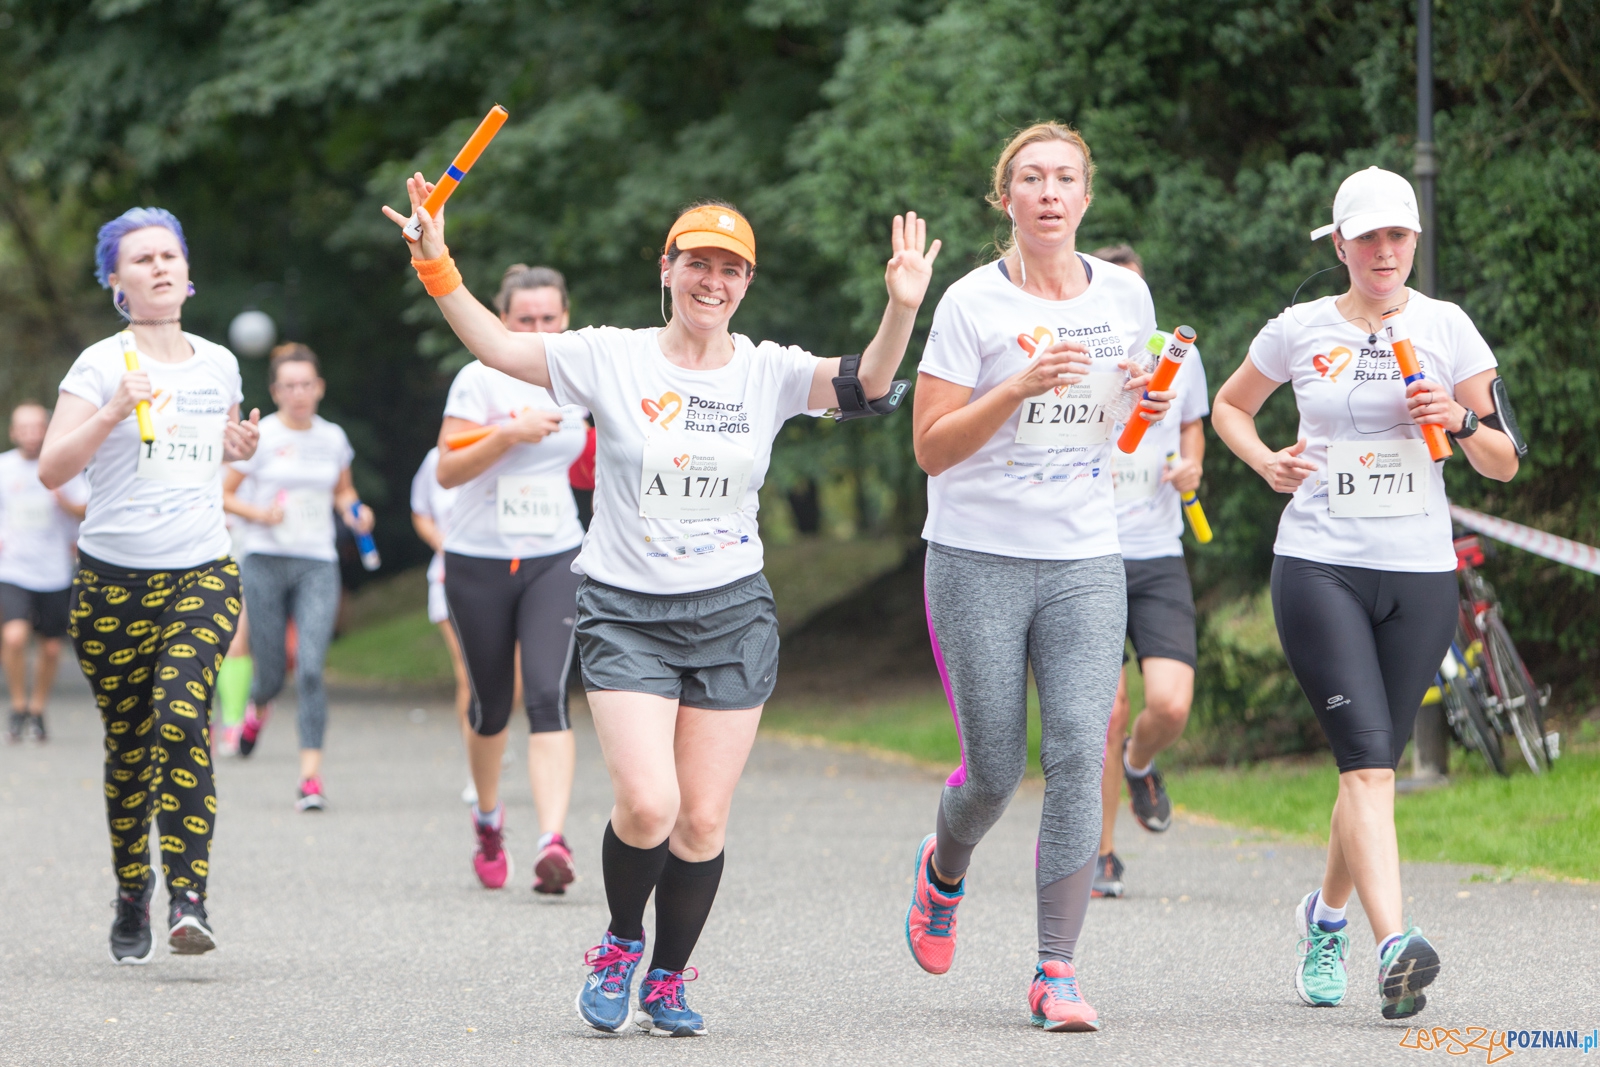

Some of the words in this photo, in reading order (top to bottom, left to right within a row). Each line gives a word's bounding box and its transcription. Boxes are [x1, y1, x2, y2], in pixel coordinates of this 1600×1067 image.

[1057, 322, 1111, 337] Poznań
[1094, 345, 1124, 358] 2016
[1168, 343, 1188, 358] 202
[1353, 370, 1388, 381] Run
[1025, 402, 1046, 424] E
[684, 420, 716, 432] Run
[718, 422, 750, 434] 2016
[166, 442, 213, 462] 274/1
[645, 472, 669, 496] A
[681, 475, 729, 498] 17/1
[1335, 472, 1356, 496] B
[1368, 472, 1415, 495] 77/1
